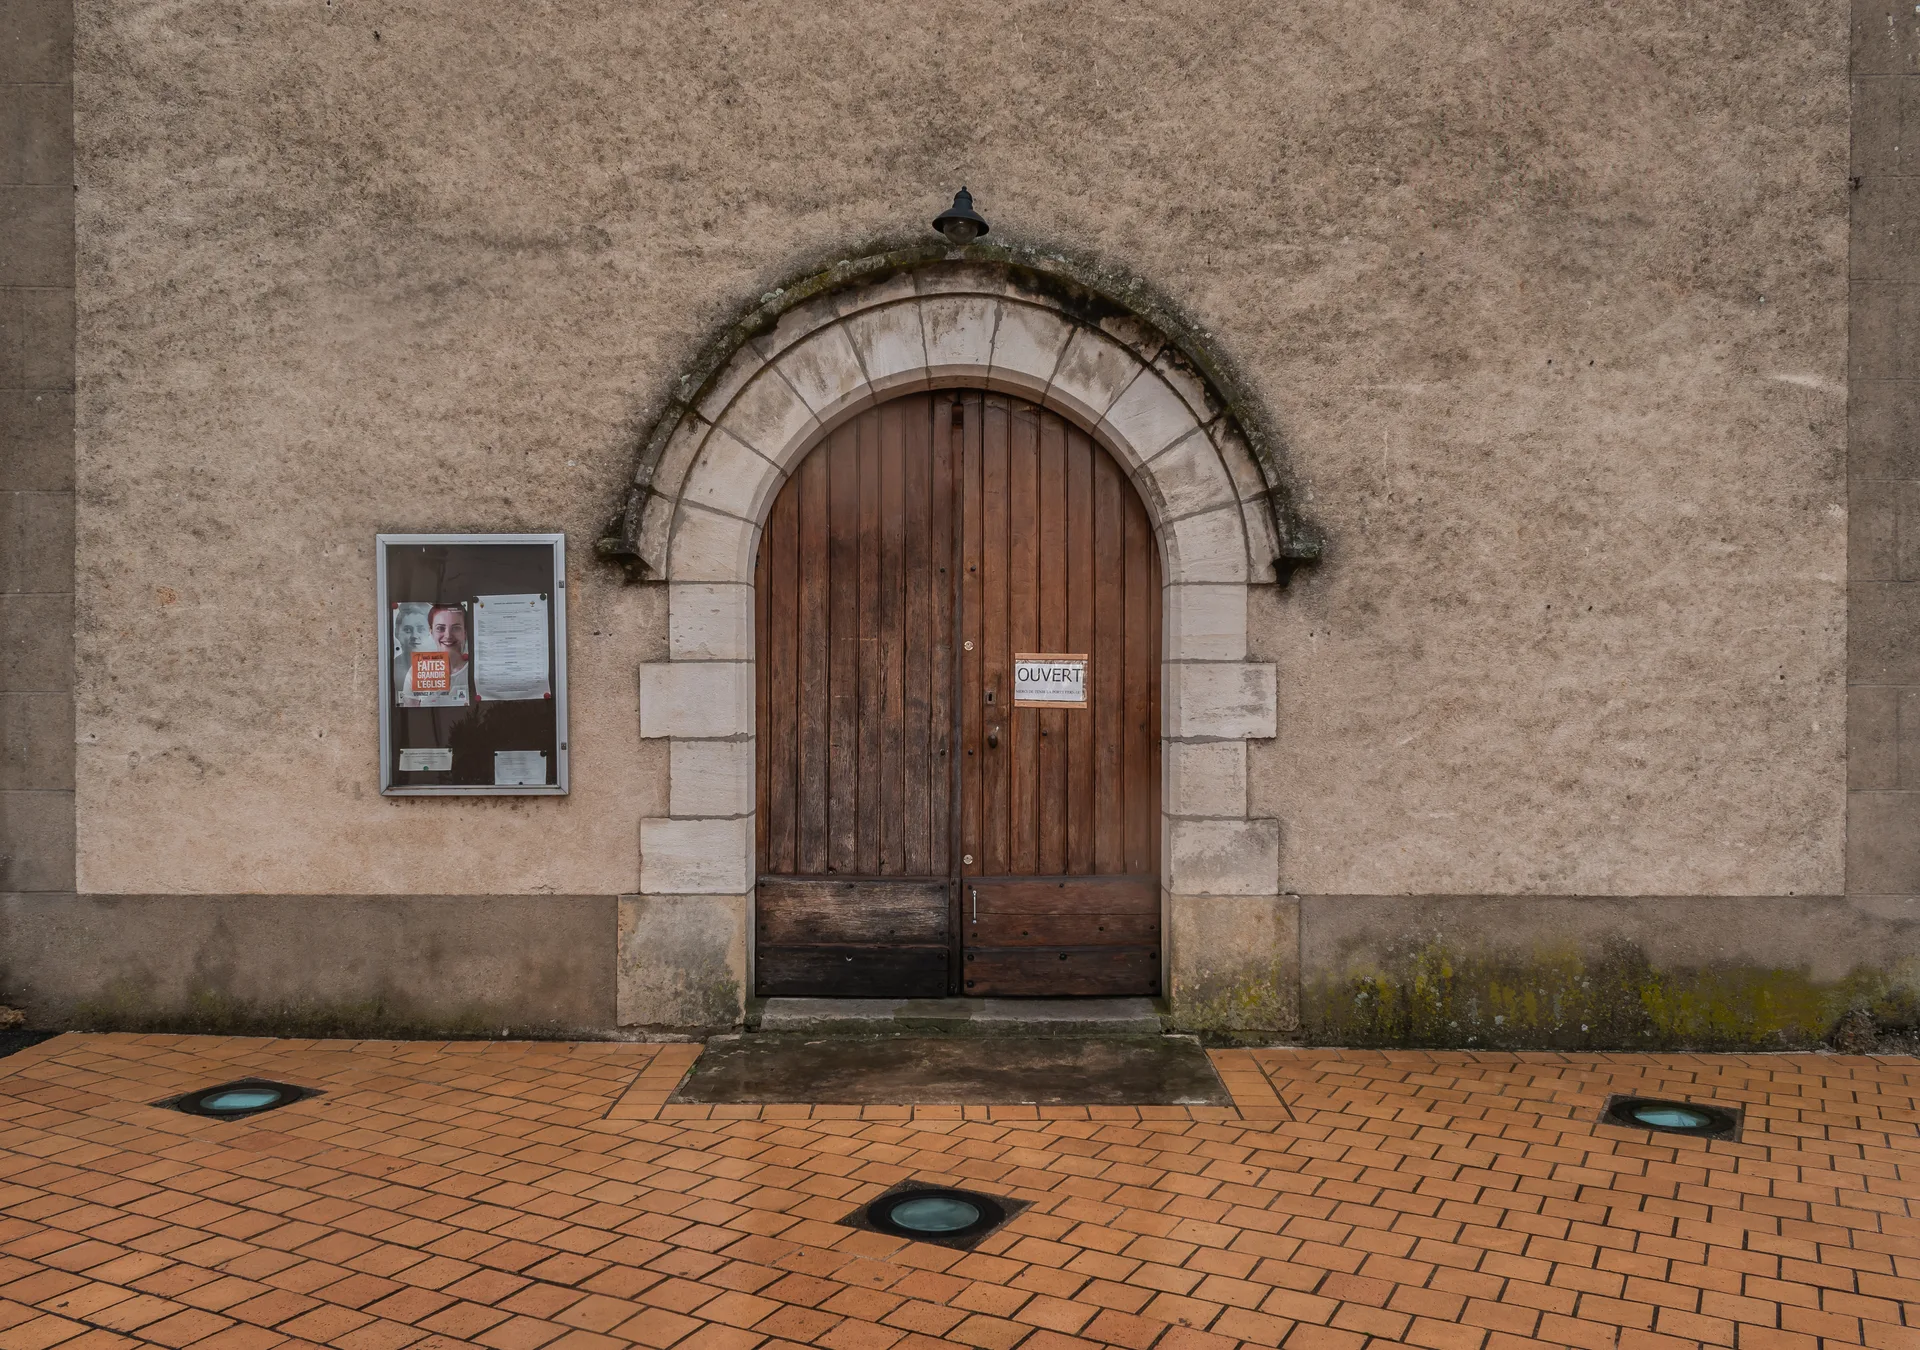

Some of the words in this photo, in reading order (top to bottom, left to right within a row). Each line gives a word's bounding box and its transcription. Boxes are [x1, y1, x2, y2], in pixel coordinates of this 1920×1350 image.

[417, 660, 445, 671] FAITES
[417, 671, 445, 679] GRANDIR
[1017, 667, 1083, 682] OUVERT
